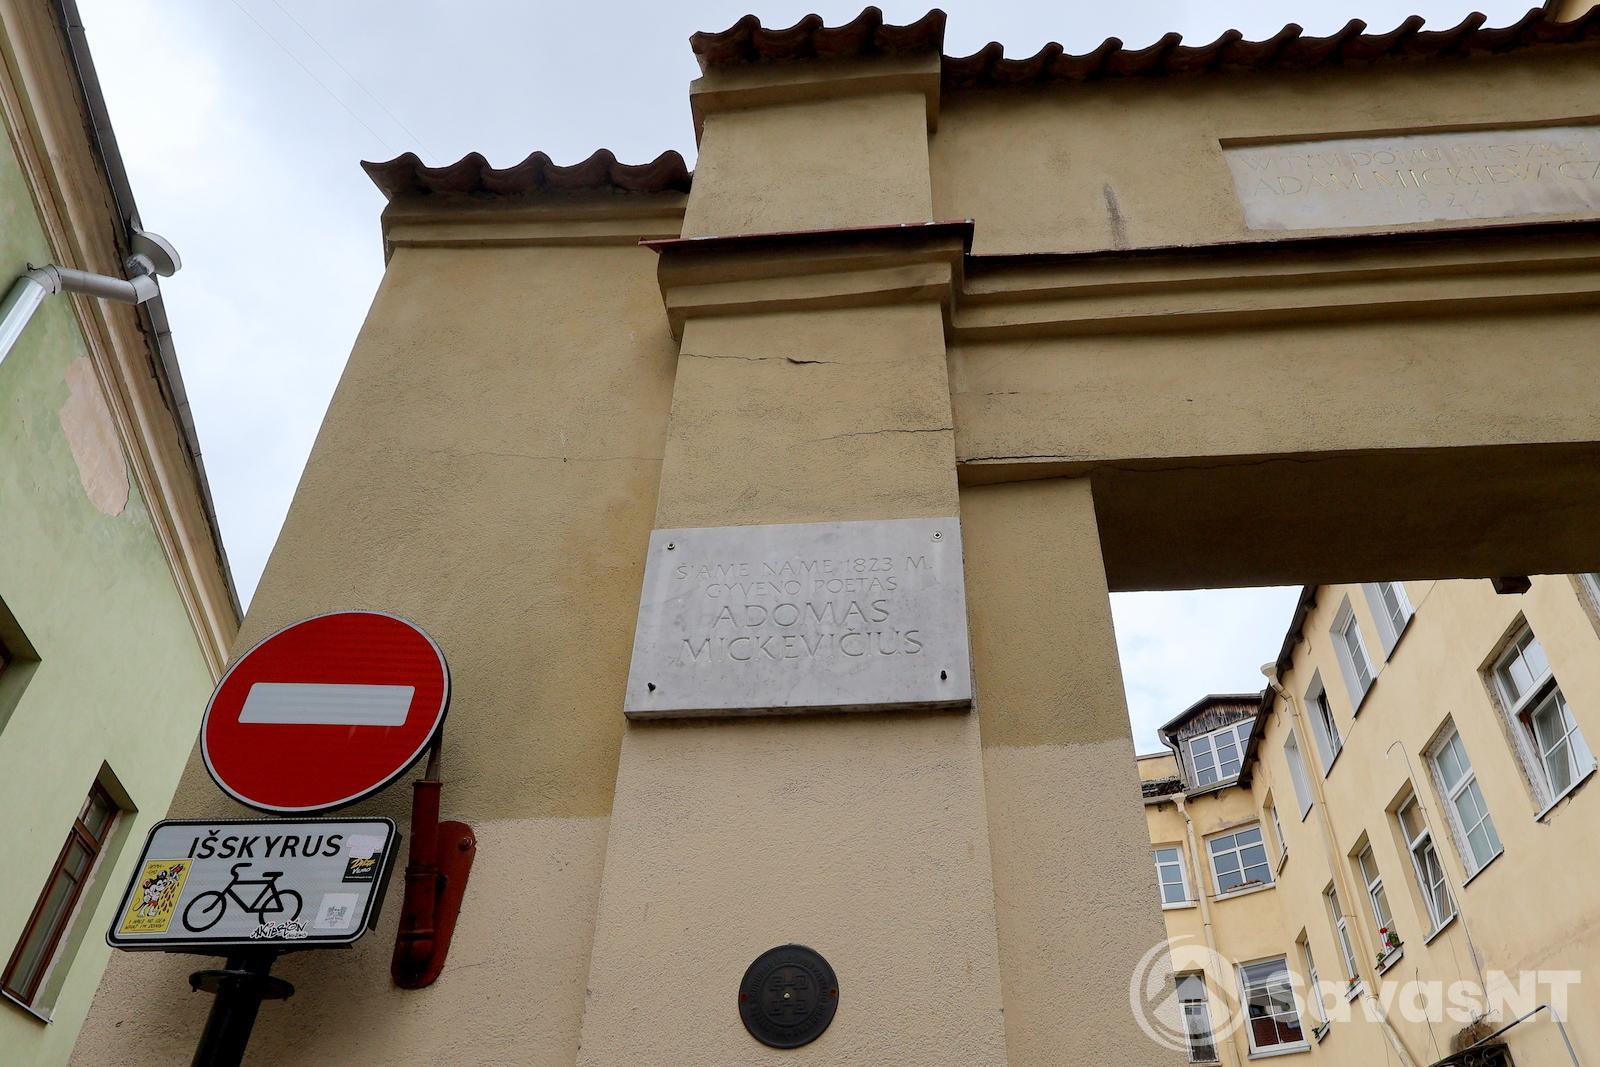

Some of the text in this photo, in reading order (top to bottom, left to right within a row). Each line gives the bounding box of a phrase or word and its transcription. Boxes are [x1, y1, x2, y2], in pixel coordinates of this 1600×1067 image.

[1253, 173, 1365, 197] ADAM
[763, 559, 834, 577] NAME
[846, 557, 893, 573] 1823
[814, 576, 897, 594] POETAS
[712, 599, 890, 629] ADOMAS
[680, 628, 923, 663] MICKEVIČIUS
[187, 829, 344, 859] IŠSKYRUS
